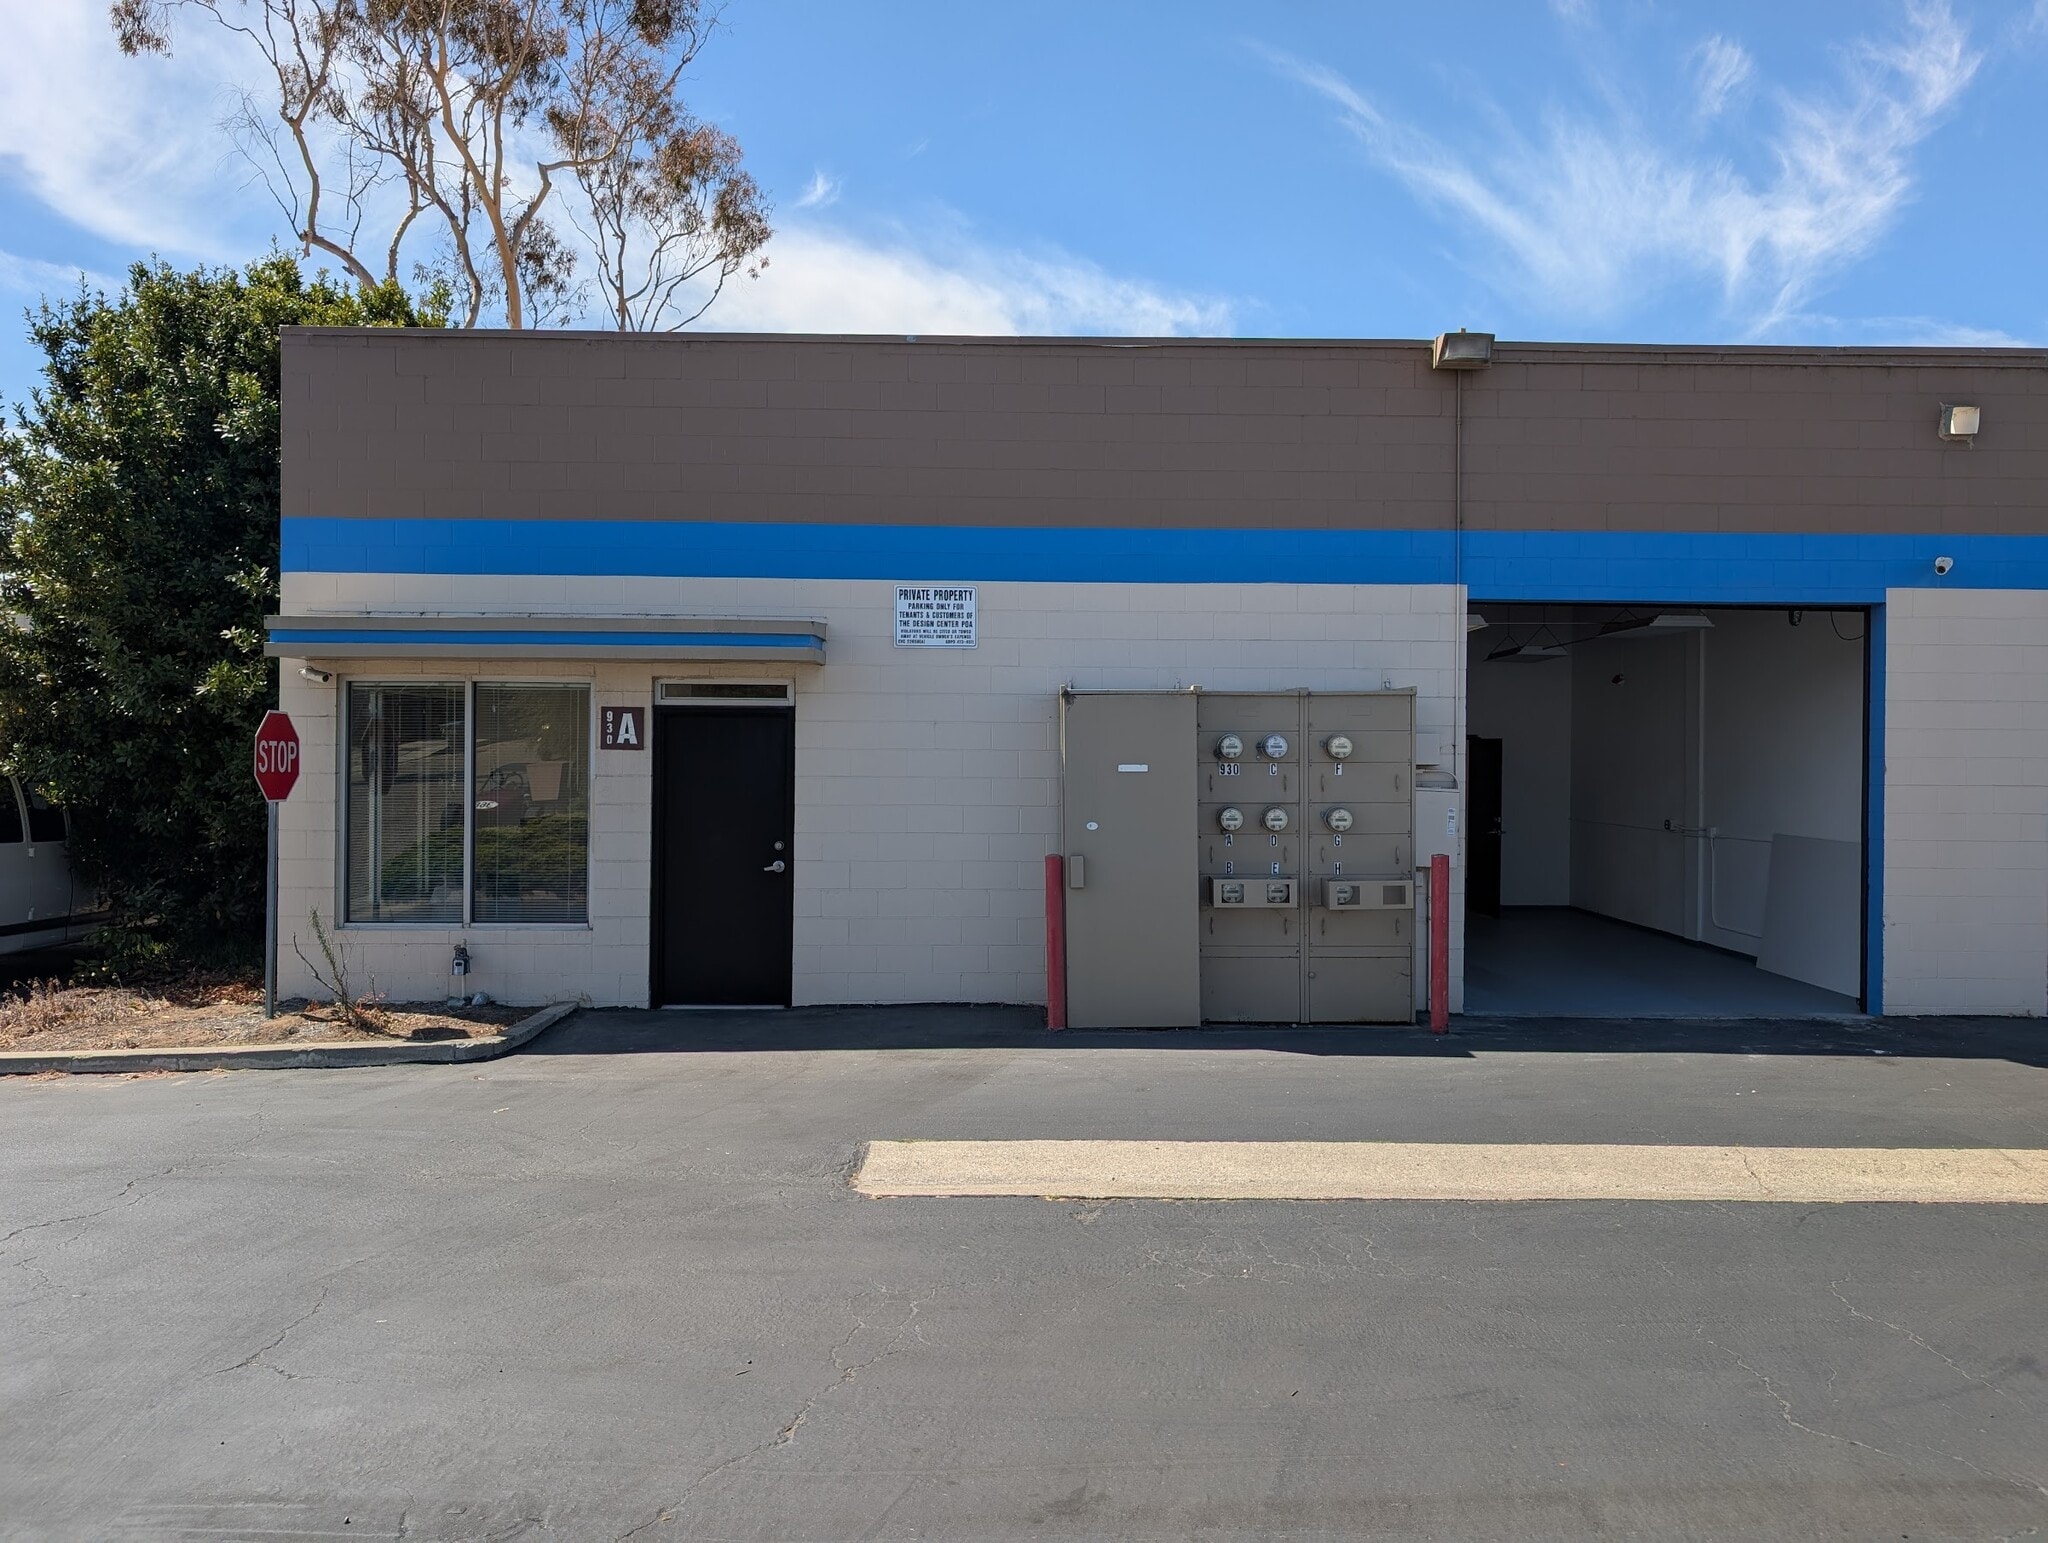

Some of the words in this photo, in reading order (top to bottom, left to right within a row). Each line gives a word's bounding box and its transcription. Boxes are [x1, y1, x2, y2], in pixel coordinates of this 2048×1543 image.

[899, 589, 930, 600] PRIVATE
[934, 590, 973, 601] PROPERTY
[616, 712, 638, 744] A
[258, 740, 297, 773] STOP
[1220, 763, 1240, 775] 930
[1270, 763, 1277, 775] C
[1335, 764, 1342, 775] F
[1226, 835, 1233, 846] A
[1335, 834, 1341, 846] G
[1226, 862, 1232, 874] B
[1273, 862, 1278, 874] E
[1335, 862, 1341, 874] H
